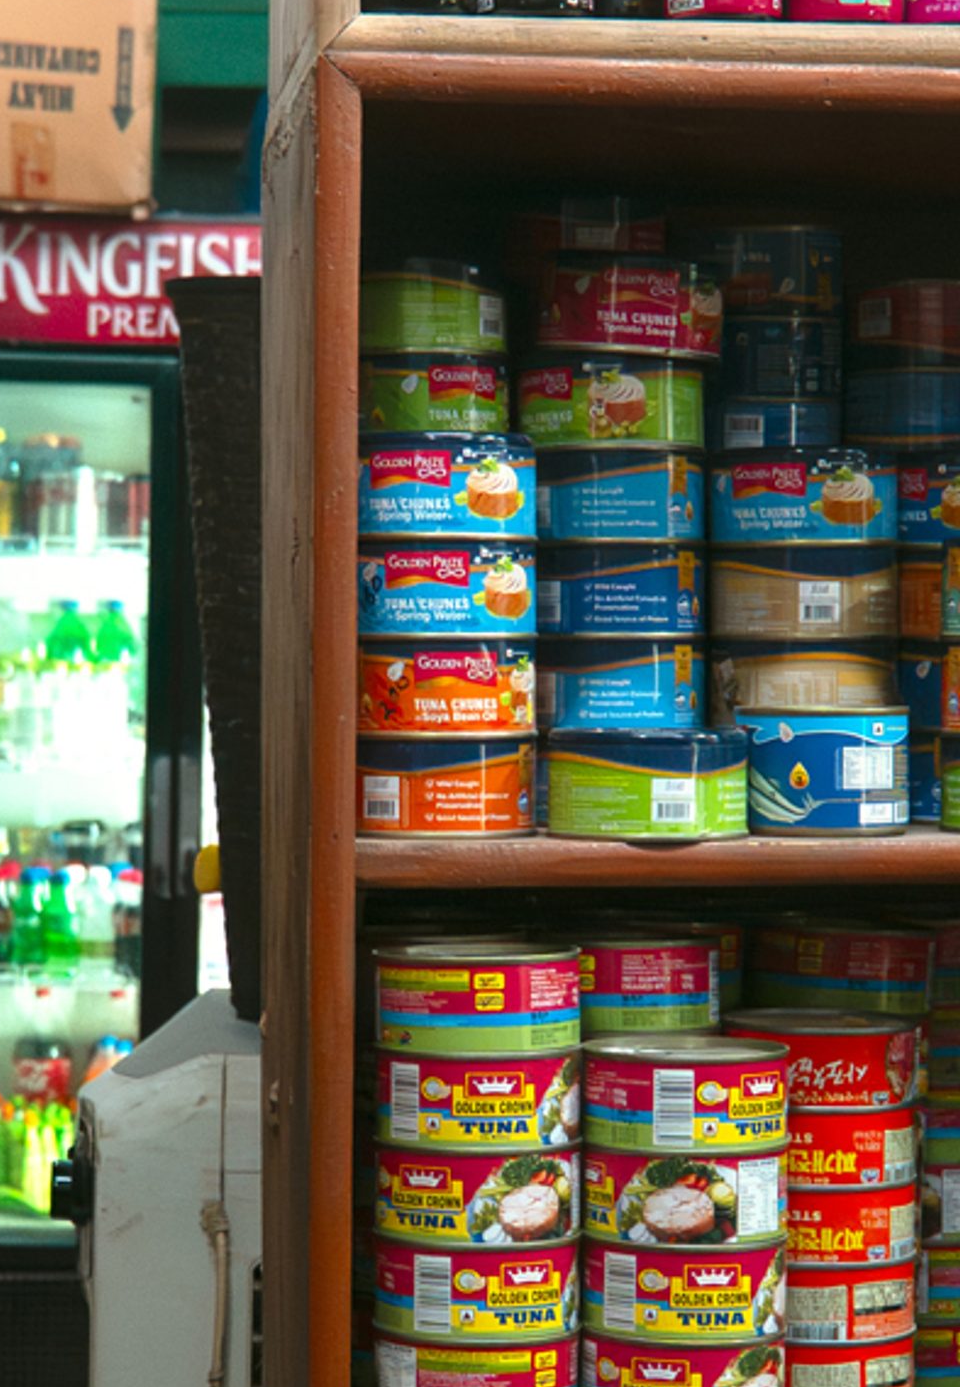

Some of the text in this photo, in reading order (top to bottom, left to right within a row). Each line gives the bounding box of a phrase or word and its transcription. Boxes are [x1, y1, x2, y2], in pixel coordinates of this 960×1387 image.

[387, 554, 432, 568] GOLDEN
[384, 595, 471, 610] TUNA CHUNKS
[417, 655, 461, 669] GOLDEN
[413, 698, 498, 710] TUNA CHUNKS
[455, 1099, 533, 1114] GOLDEN CROWN
[458, 1119, 530, 1134] TUNA
[735, 1119, 781, 1136] TUNA
[425, 1193, 462, 1208] CROWN
[395, 1212, 457, 1229] TUNA
[489, 1292, 529, 1305] GOLDEN
[673, 1291, 751, 1306] GOLDEN CROWN
[494, 1308, 557, 1325] TUNA
[676, 1312, 746, 1326] TUNA
